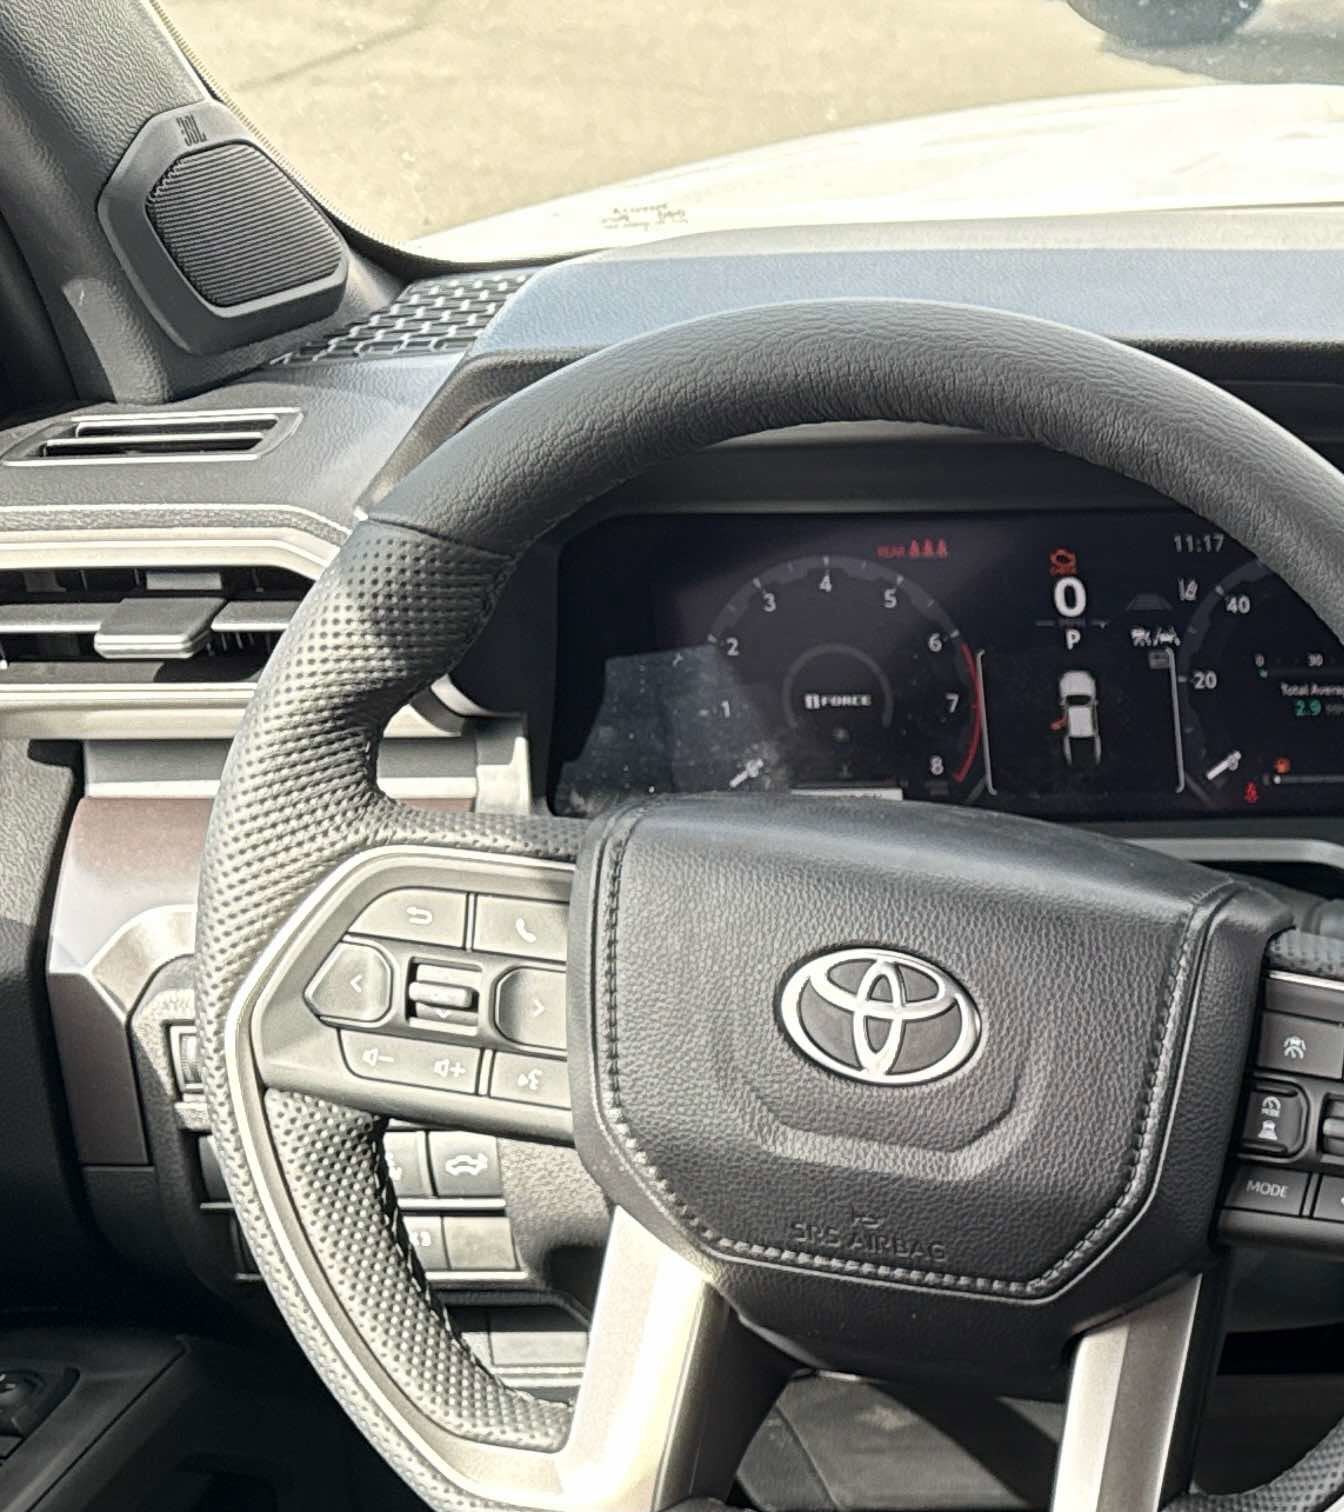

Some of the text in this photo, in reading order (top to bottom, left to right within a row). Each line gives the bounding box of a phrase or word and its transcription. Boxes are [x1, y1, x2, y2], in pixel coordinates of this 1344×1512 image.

[1172, 534, 1226, 553] 11:17
[818, 576, 833, 594] 4
[763, 593, 777, 613] 3
[883, 590, 898, 610] 5
[1054, 576, 1087, 618] 0
[1226, 595, 1252, 616] 40
[726, 638, 740, 657] 2
[927, 633, 943, 653] 6
[1065, 628, 1081, 651] P
[1193, 670, 1218, 691] 20
[1280, 682, 1309, 697] Total
[720, 700, 731, 718] 1
[945, 693, 958, 712] 7
[929, 755, 945, 776] 8
[1246, 1179, 1289, 1199] MODE
